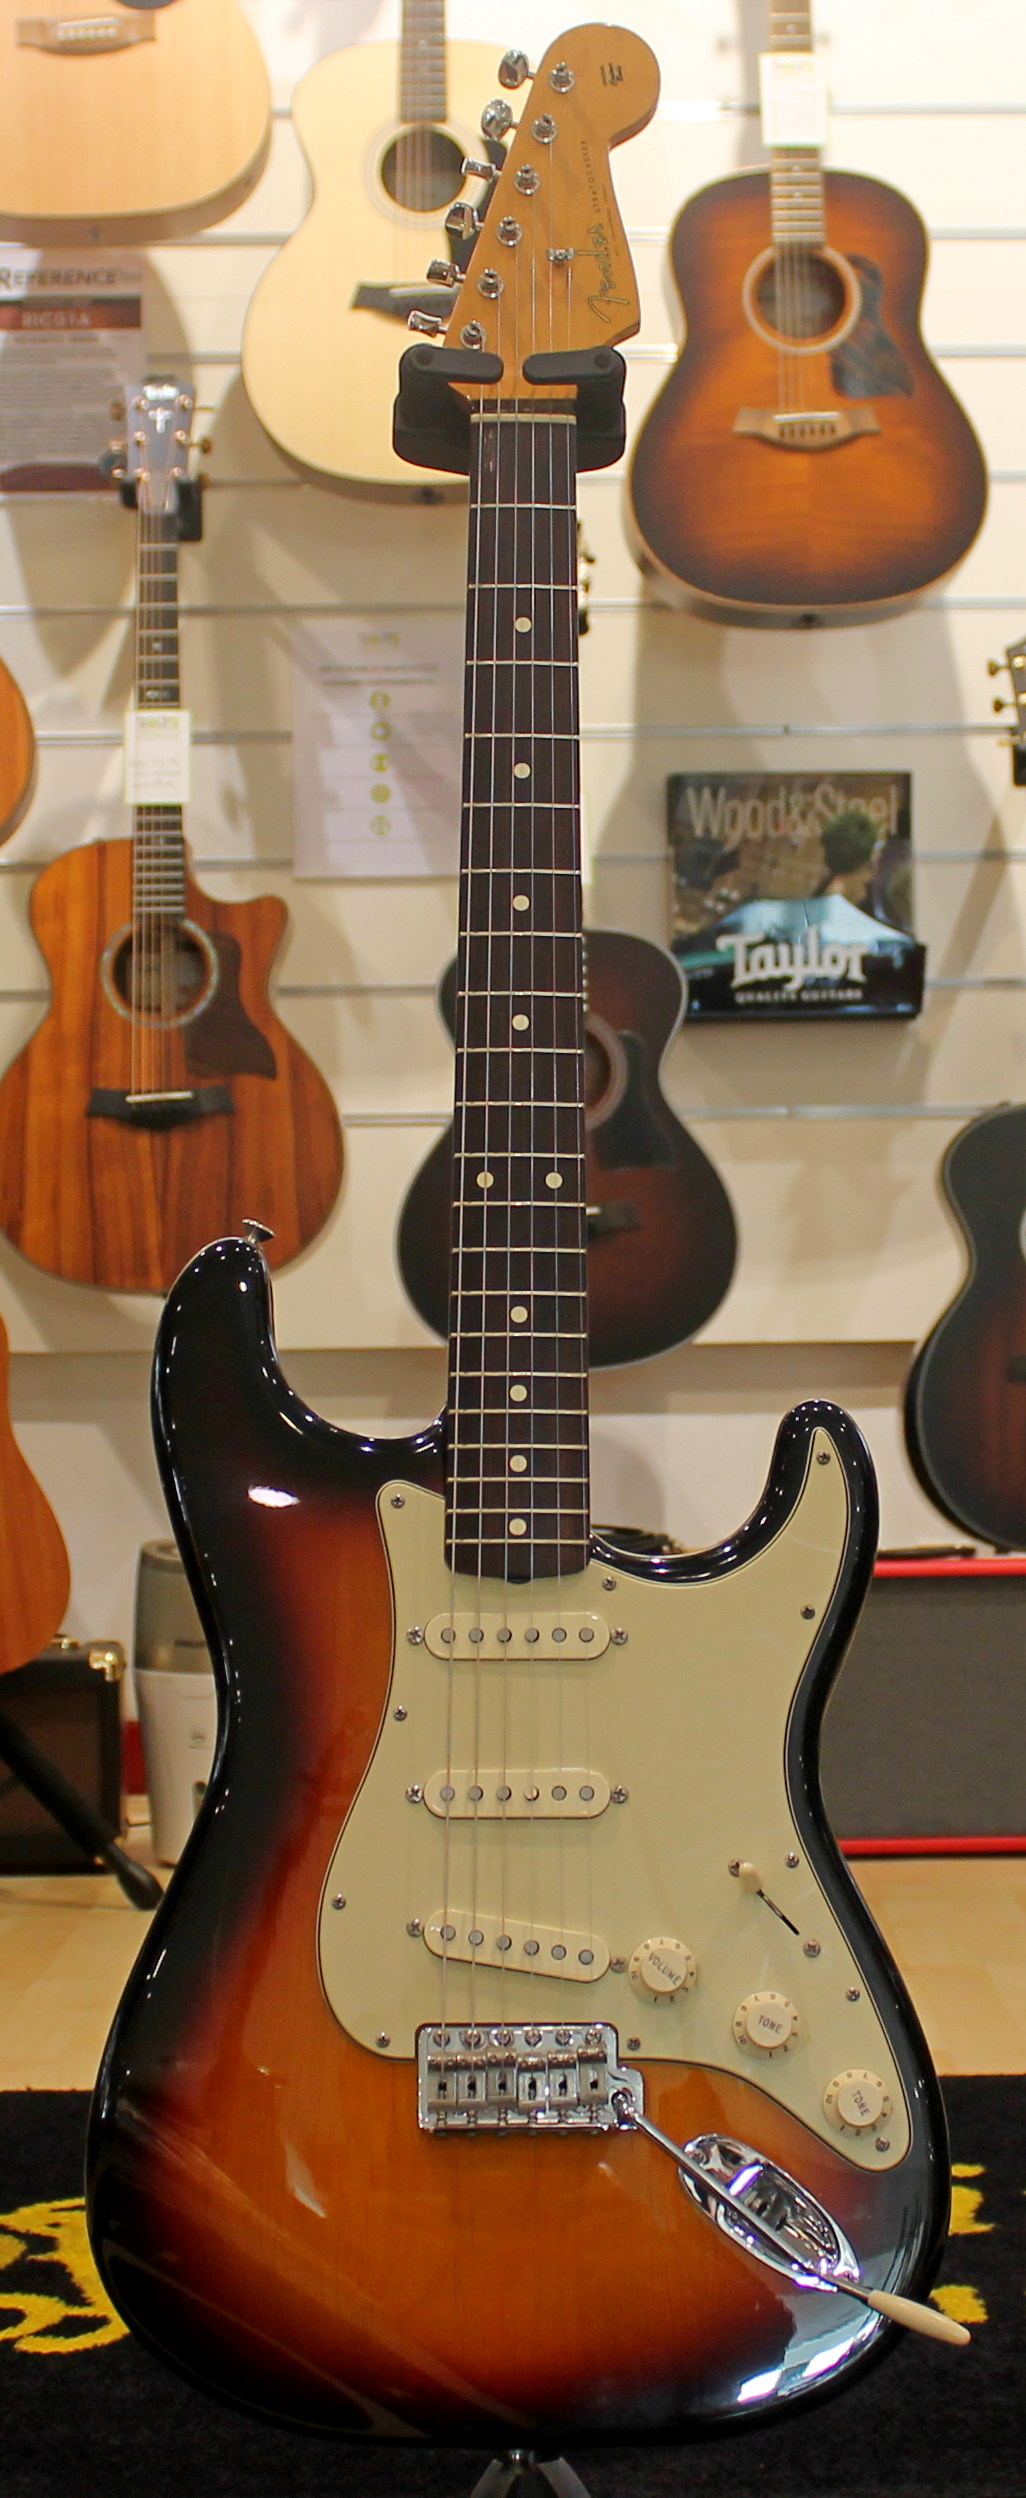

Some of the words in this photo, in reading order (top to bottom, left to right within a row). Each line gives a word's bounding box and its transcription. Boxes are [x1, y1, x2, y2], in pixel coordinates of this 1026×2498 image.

[577, 222, 630, 323] Fender
[715, 926, 868, 991] Taylor
[648, 1952, 682, 1986] VOLUME
[758, 2014, 783, 2034] TONE
[851, 2089, 870, 2116] TONE
